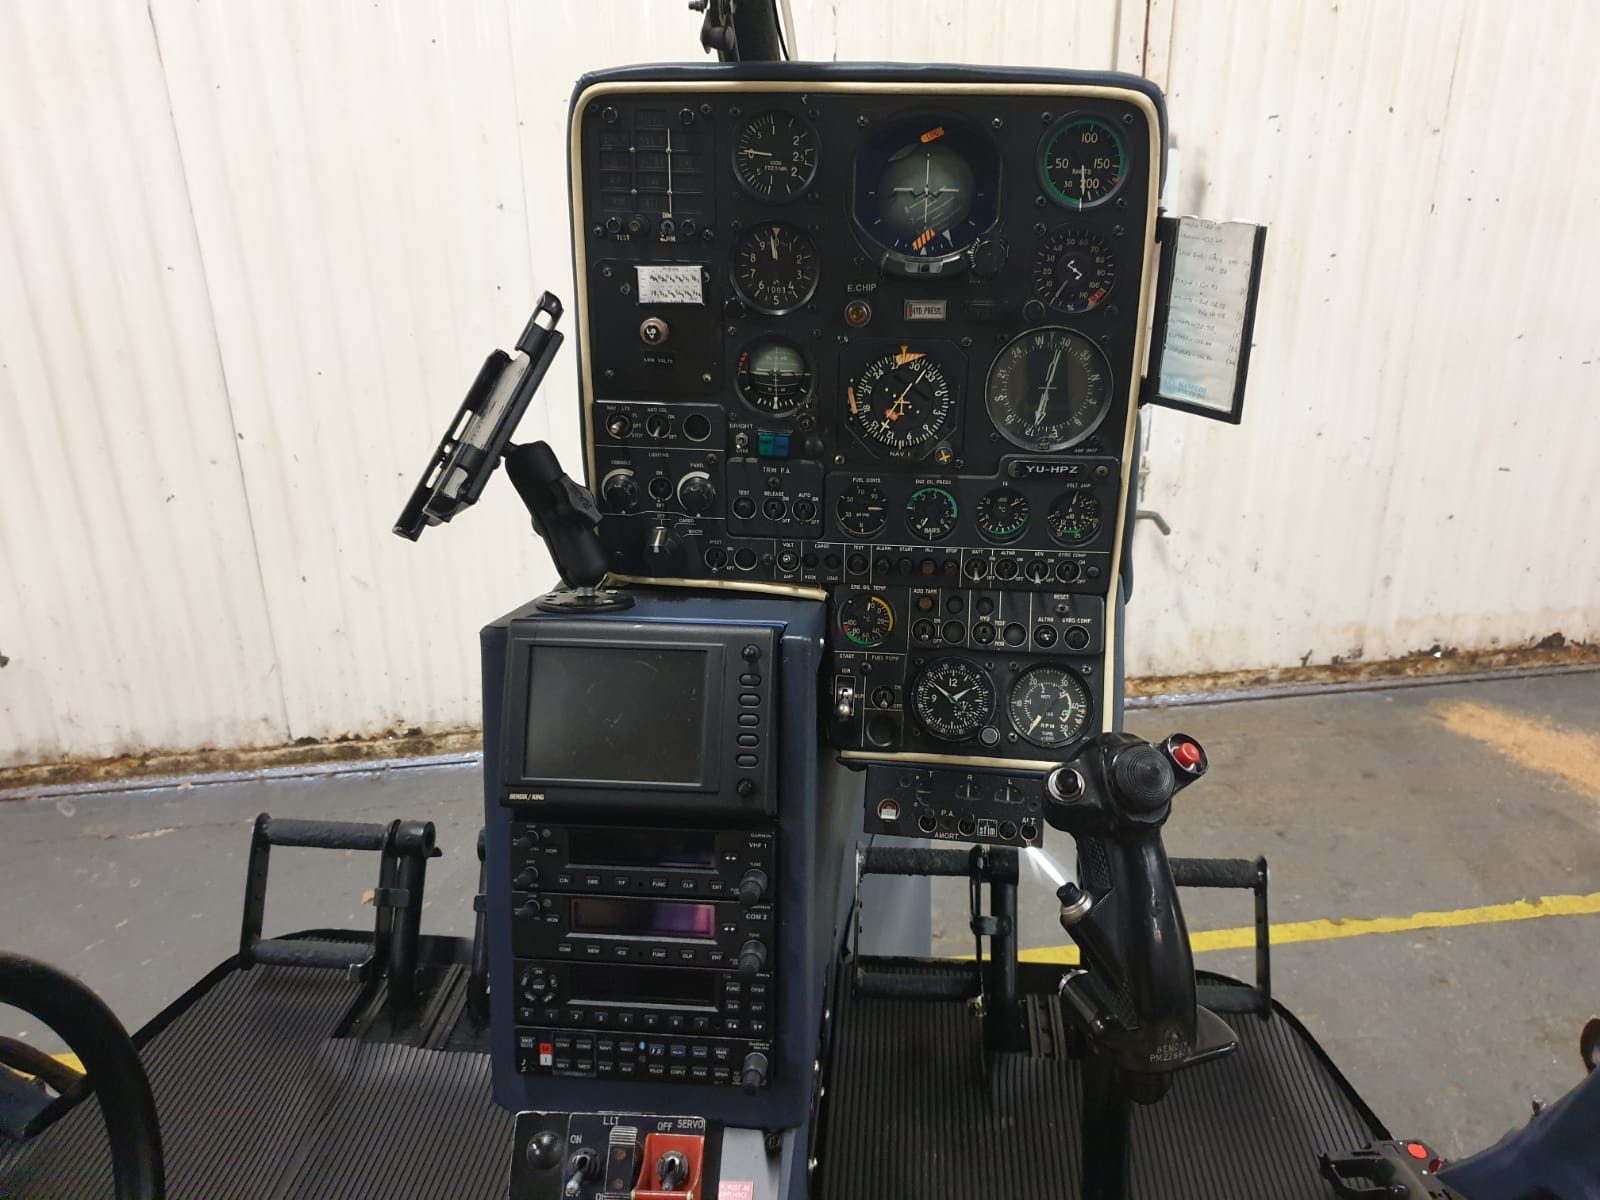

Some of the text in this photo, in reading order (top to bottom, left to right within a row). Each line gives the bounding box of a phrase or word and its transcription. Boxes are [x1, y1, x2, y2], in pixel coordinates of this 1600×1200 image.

[793, 136, 800, 145] 2
[1081, 132, 1098, 144] 100
[1055, 158, 1069, 169] 50
[1093, 158, 1110, 169] 150
[791, 167, 798, 177] 2
[1064, 180, 1073, 188] 30
[759, 241, 766, 251] 9
[1053, 244, 1063, 252] 40
[750, 253, 757, 263] 8
[796, 255, 803, 265] 2
[750, 268, 756, 279] 7
[796, 270, 802, 280] 3
[758, 280, 765, 290] 6
[788, 280, 794, 289] 4
[847, 282, 877, 293] E.CHIP
[767, 286, 786, 294] 1003
[773, 295, 780, 305] 5
[1034, 335, 1044, 346] W
[1060, 337, 1071, 347] 30
[909, 361, 921, 372] 30
[873, 369, 884, 380] 24
[925, 371, 936, 383] 33
[864, 385, 873, 395] 21
[863, 404, 871, 413] 18
[886, 430, 895, 440] 12
[1026, 465, 1079, 474] YU-HPZ
[948, 678, 958, 688] 12
[1060, 679, 1069, 687] 30
[931, 694, 937, 703] 9
[1060, 724, 1069, 732] 50
[934, 832, 960, 840] AMORT.
[657, 1119, 704, 1131] OFF SERVO
[570, 1134, 583, 1145] ON
